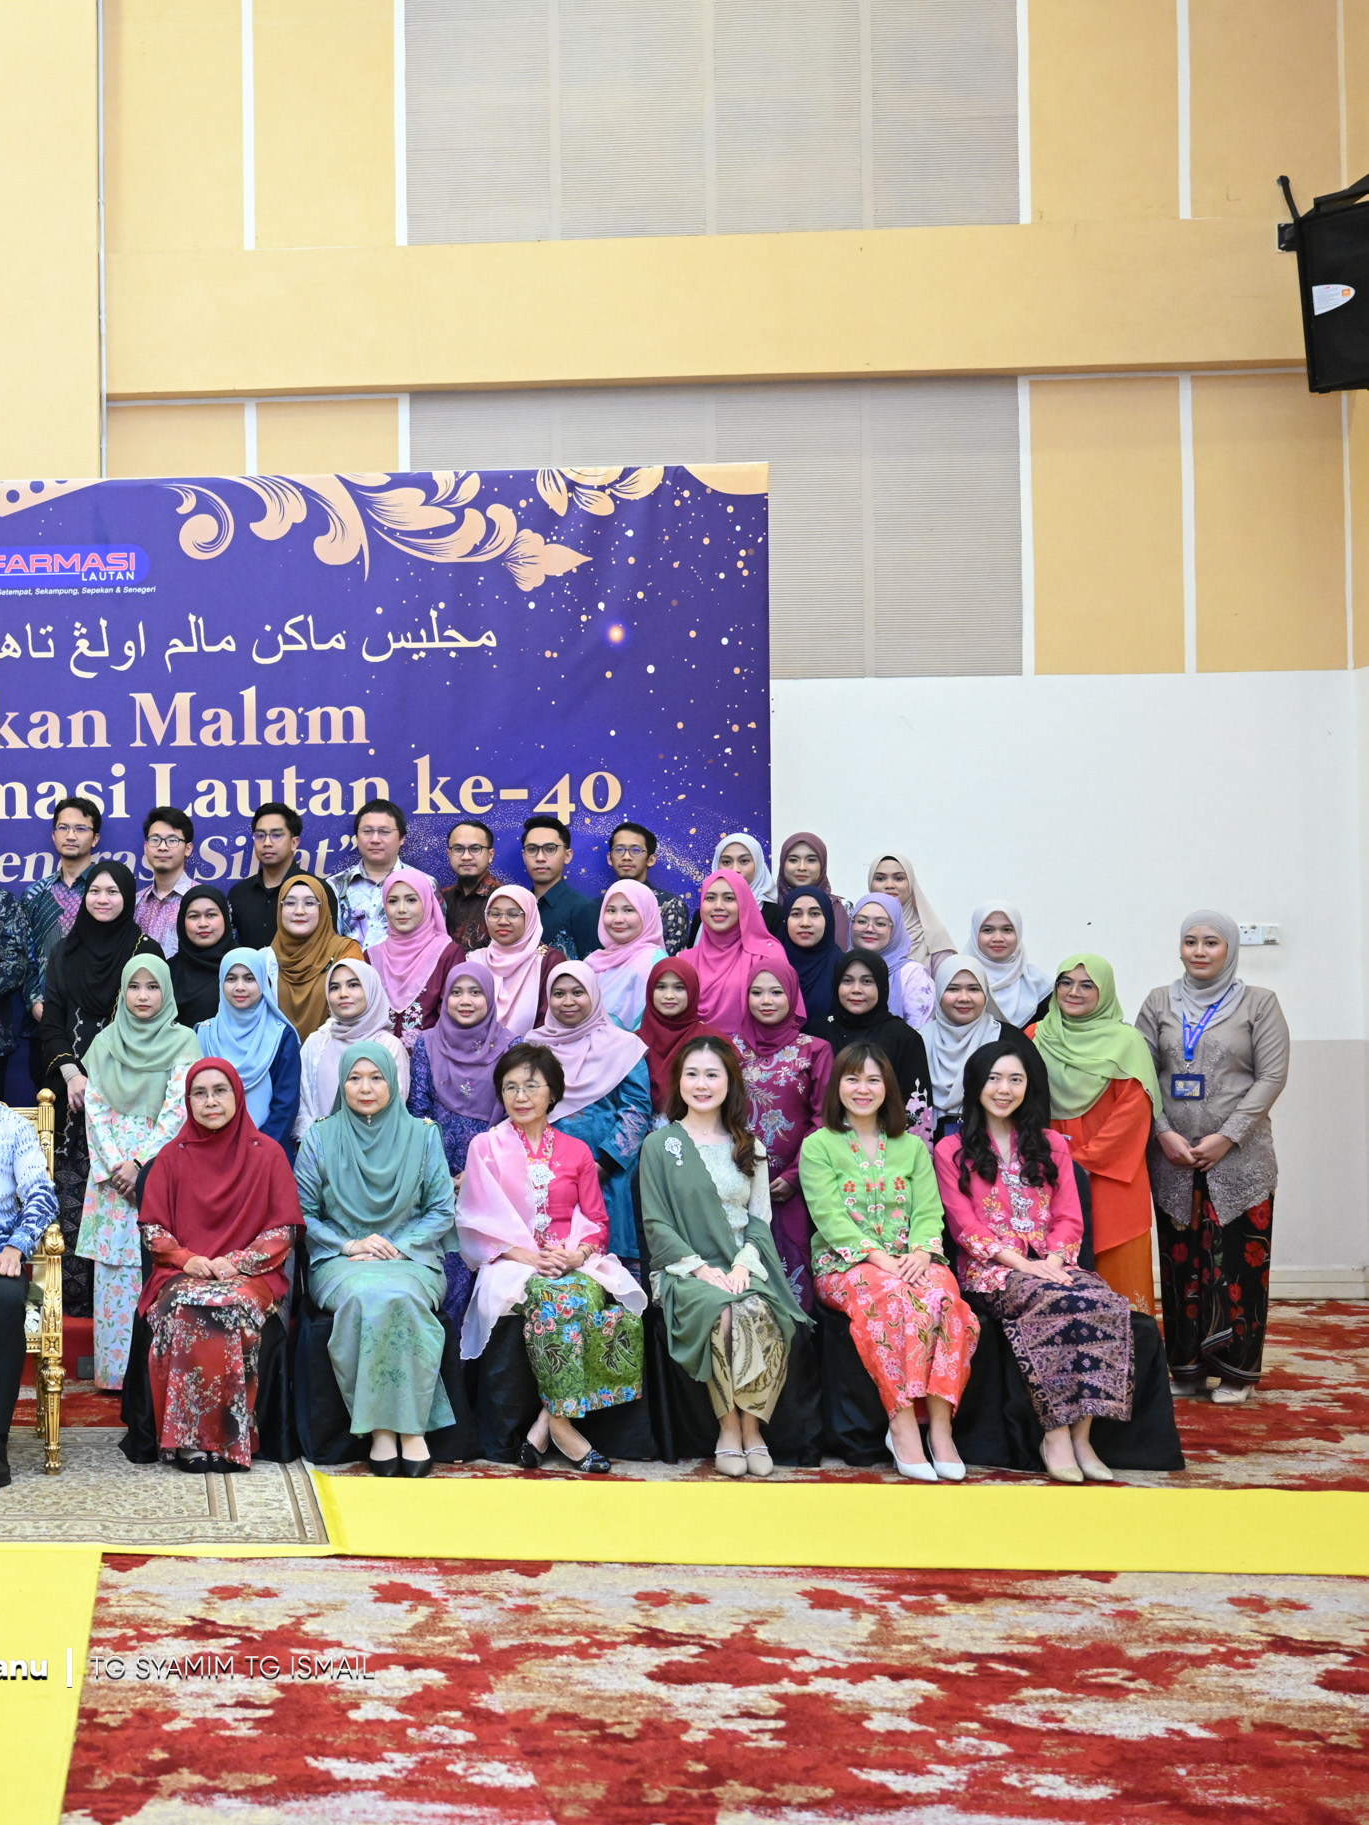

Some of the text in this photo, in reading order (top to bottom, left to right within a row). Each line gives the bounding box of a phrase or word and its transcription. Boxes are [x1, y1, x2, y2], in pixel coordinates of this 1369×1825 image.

[35, 587, 80, 596] Sekampung,
[81, 587, 113, 596] Sepekan
[123, 586, 156, 595] Senegeri
[81, 571, 135, 581] LAUTAN
[164, 612, 237, 673] مالم
[252, 614, 346, 665] ماكن
[362, 607, 497, 662] مجليس
[129, 685, 371, 746] Malam
[149, 764, 391, 817] Lautan
[412, 754, 622, 826] ke-40
